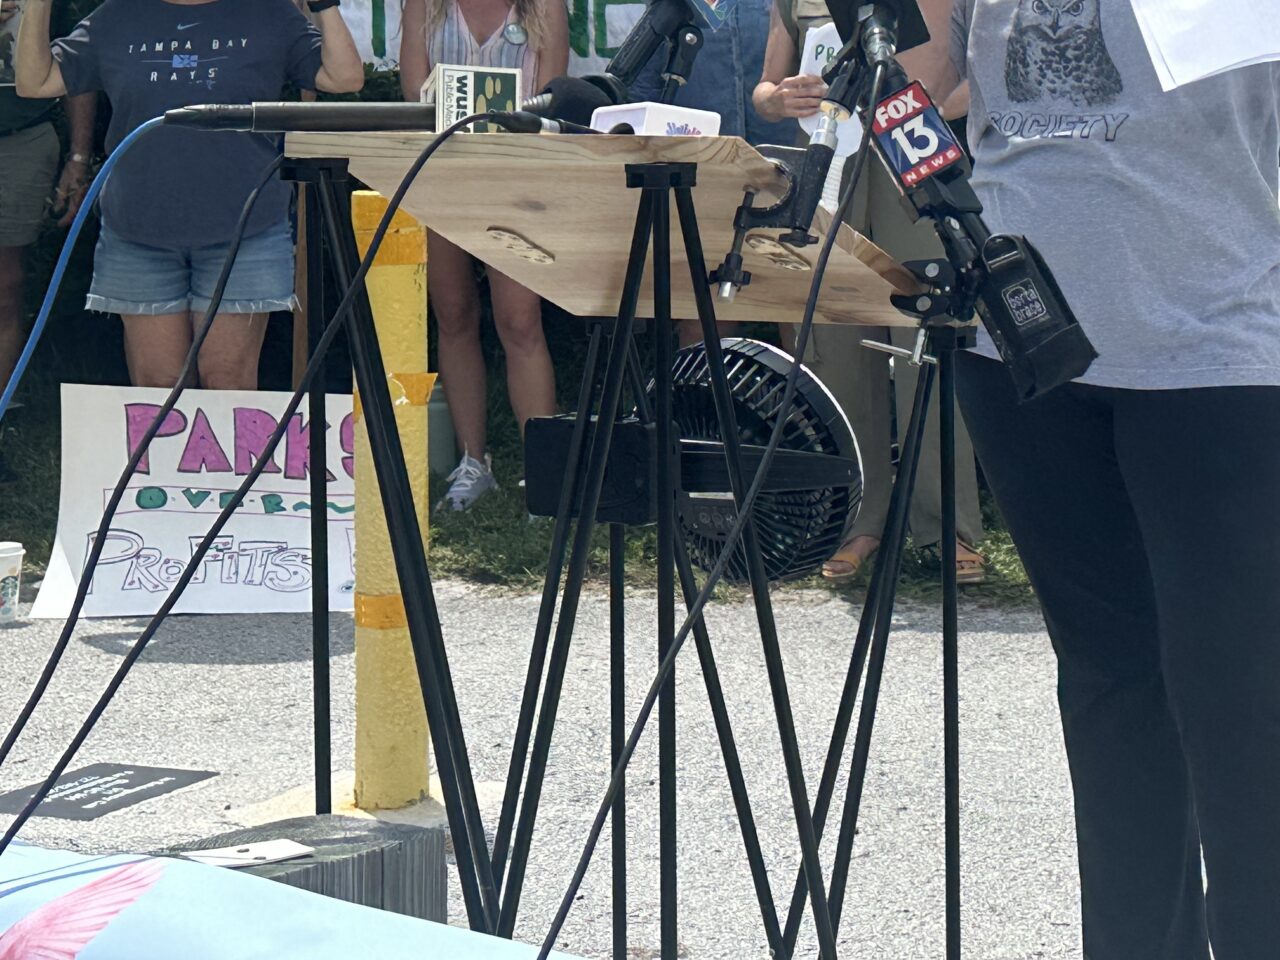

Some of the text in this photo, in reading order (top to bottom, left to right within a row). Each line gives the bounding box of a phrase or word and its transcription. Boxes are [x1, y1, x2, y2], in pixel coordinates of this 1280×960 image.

[128, 38, 247, 53] TAMPA BAY
[150, 67, 218, 82] RAYS
[876, 90, 922, 128] FOX
[891, 113, 939, 165] 13
[905, 149, 957, 184] NEWS
